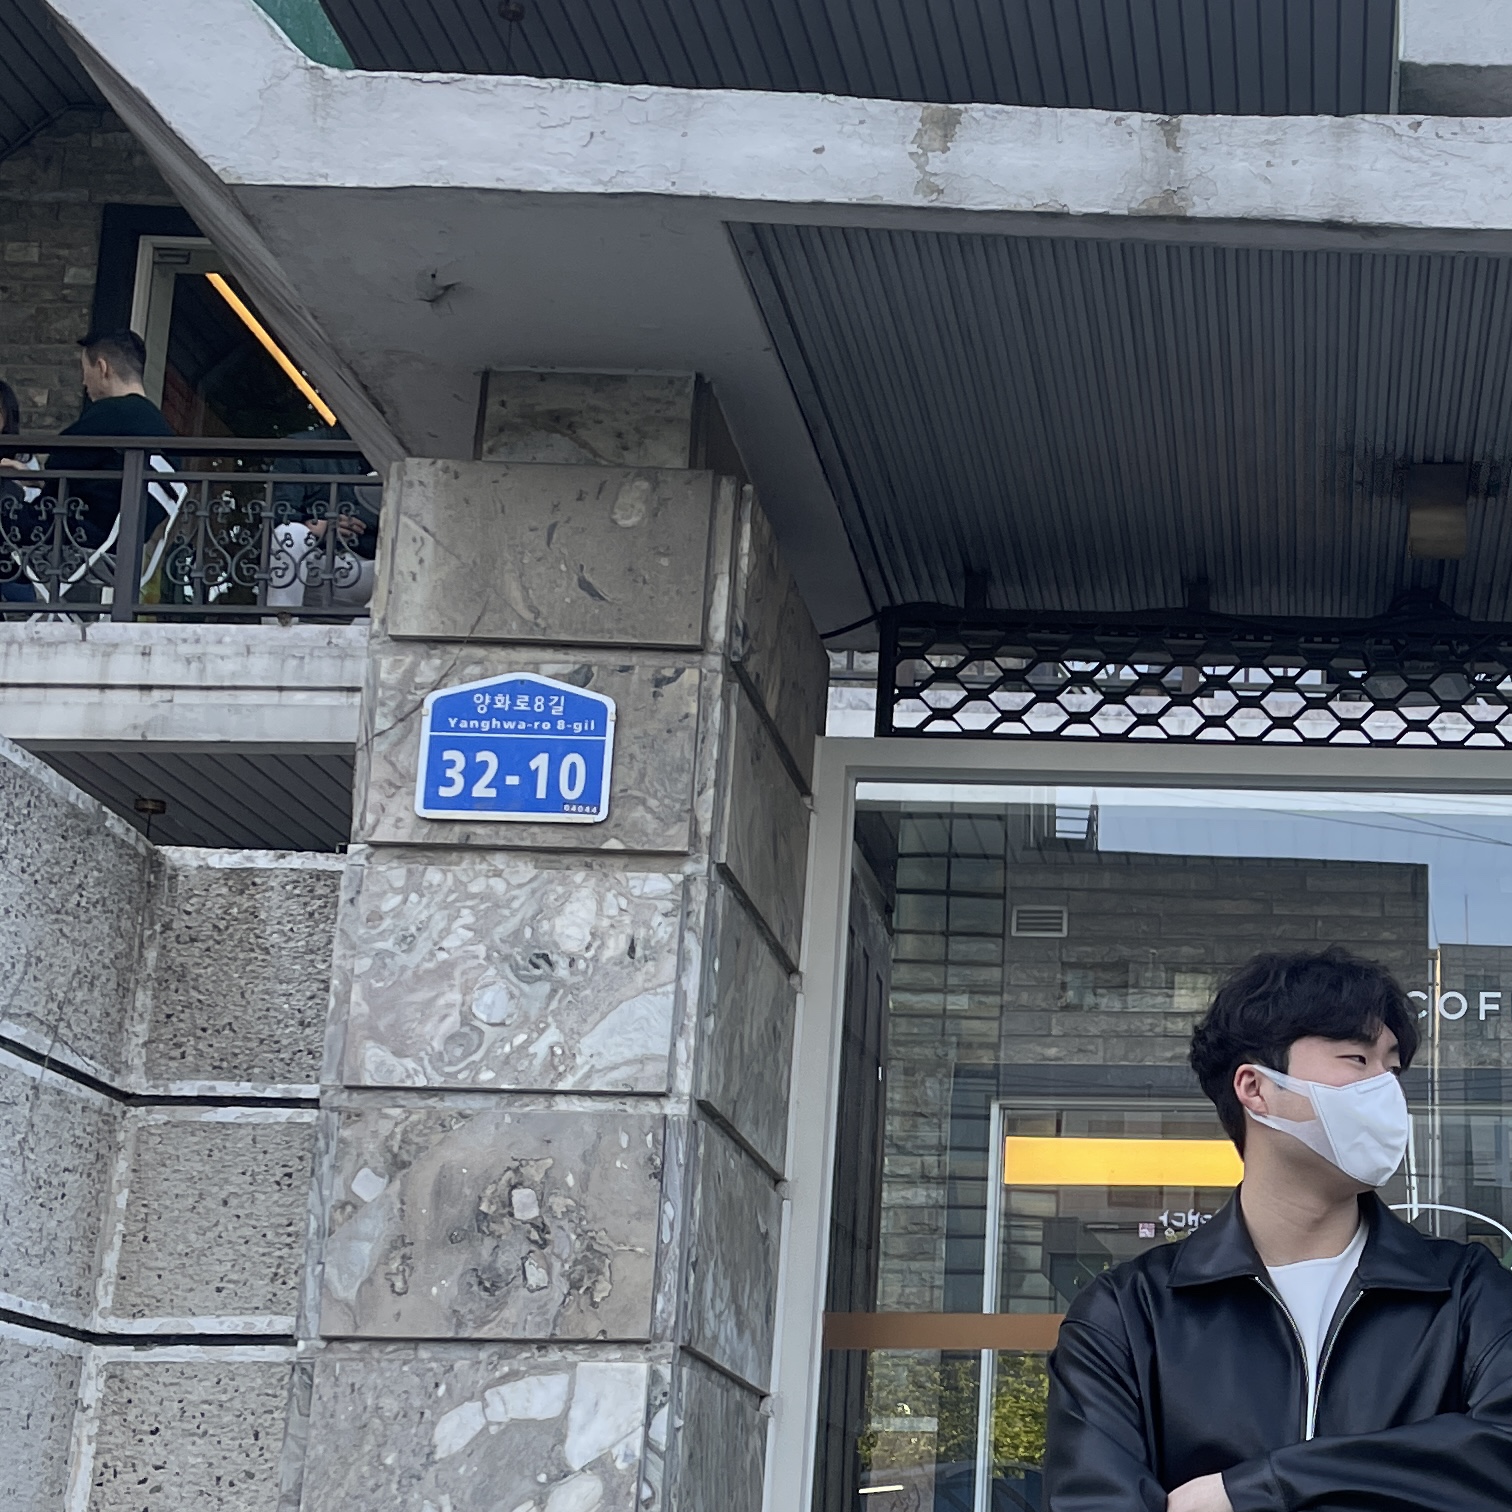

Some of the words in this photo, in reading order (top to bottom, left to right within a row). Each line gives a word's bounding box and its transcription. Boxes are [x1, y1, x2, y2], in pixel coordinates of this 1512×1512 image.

[473, 692, 565, 715] 양화로8길
[448, 717, 551, 731] Yanghwa-ro
[557, 719, 595, 733] 8-gil
[438, 749, 587, 800] 32-10
[563, 804, 597, 814] 04044
